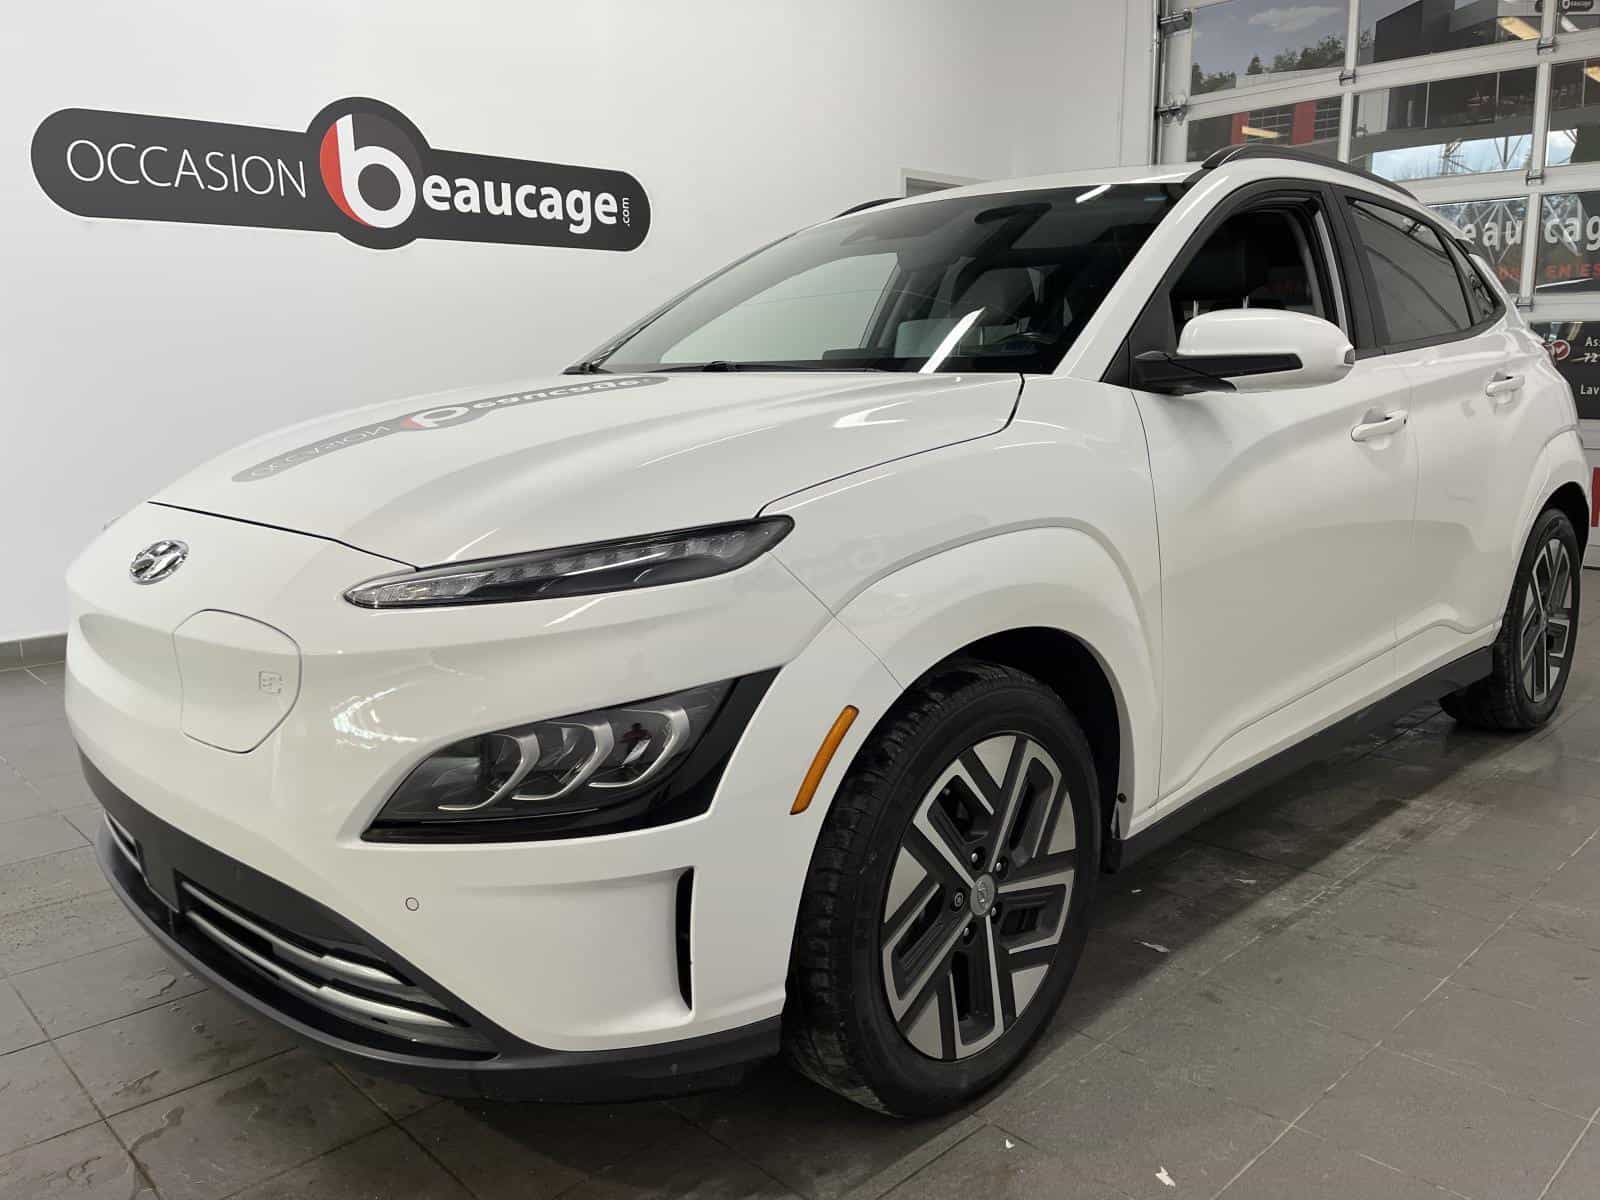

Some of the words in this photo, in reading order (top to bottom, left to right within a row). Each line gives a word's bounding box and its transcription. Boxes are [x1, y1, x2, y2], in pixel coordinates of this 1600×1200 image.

[66, 139, 306, 199] OCCASION
[335, 113, 618, 234] beaucage
[622, 196, 631, 227] .com
[1585, 336, 1600, 347] As
